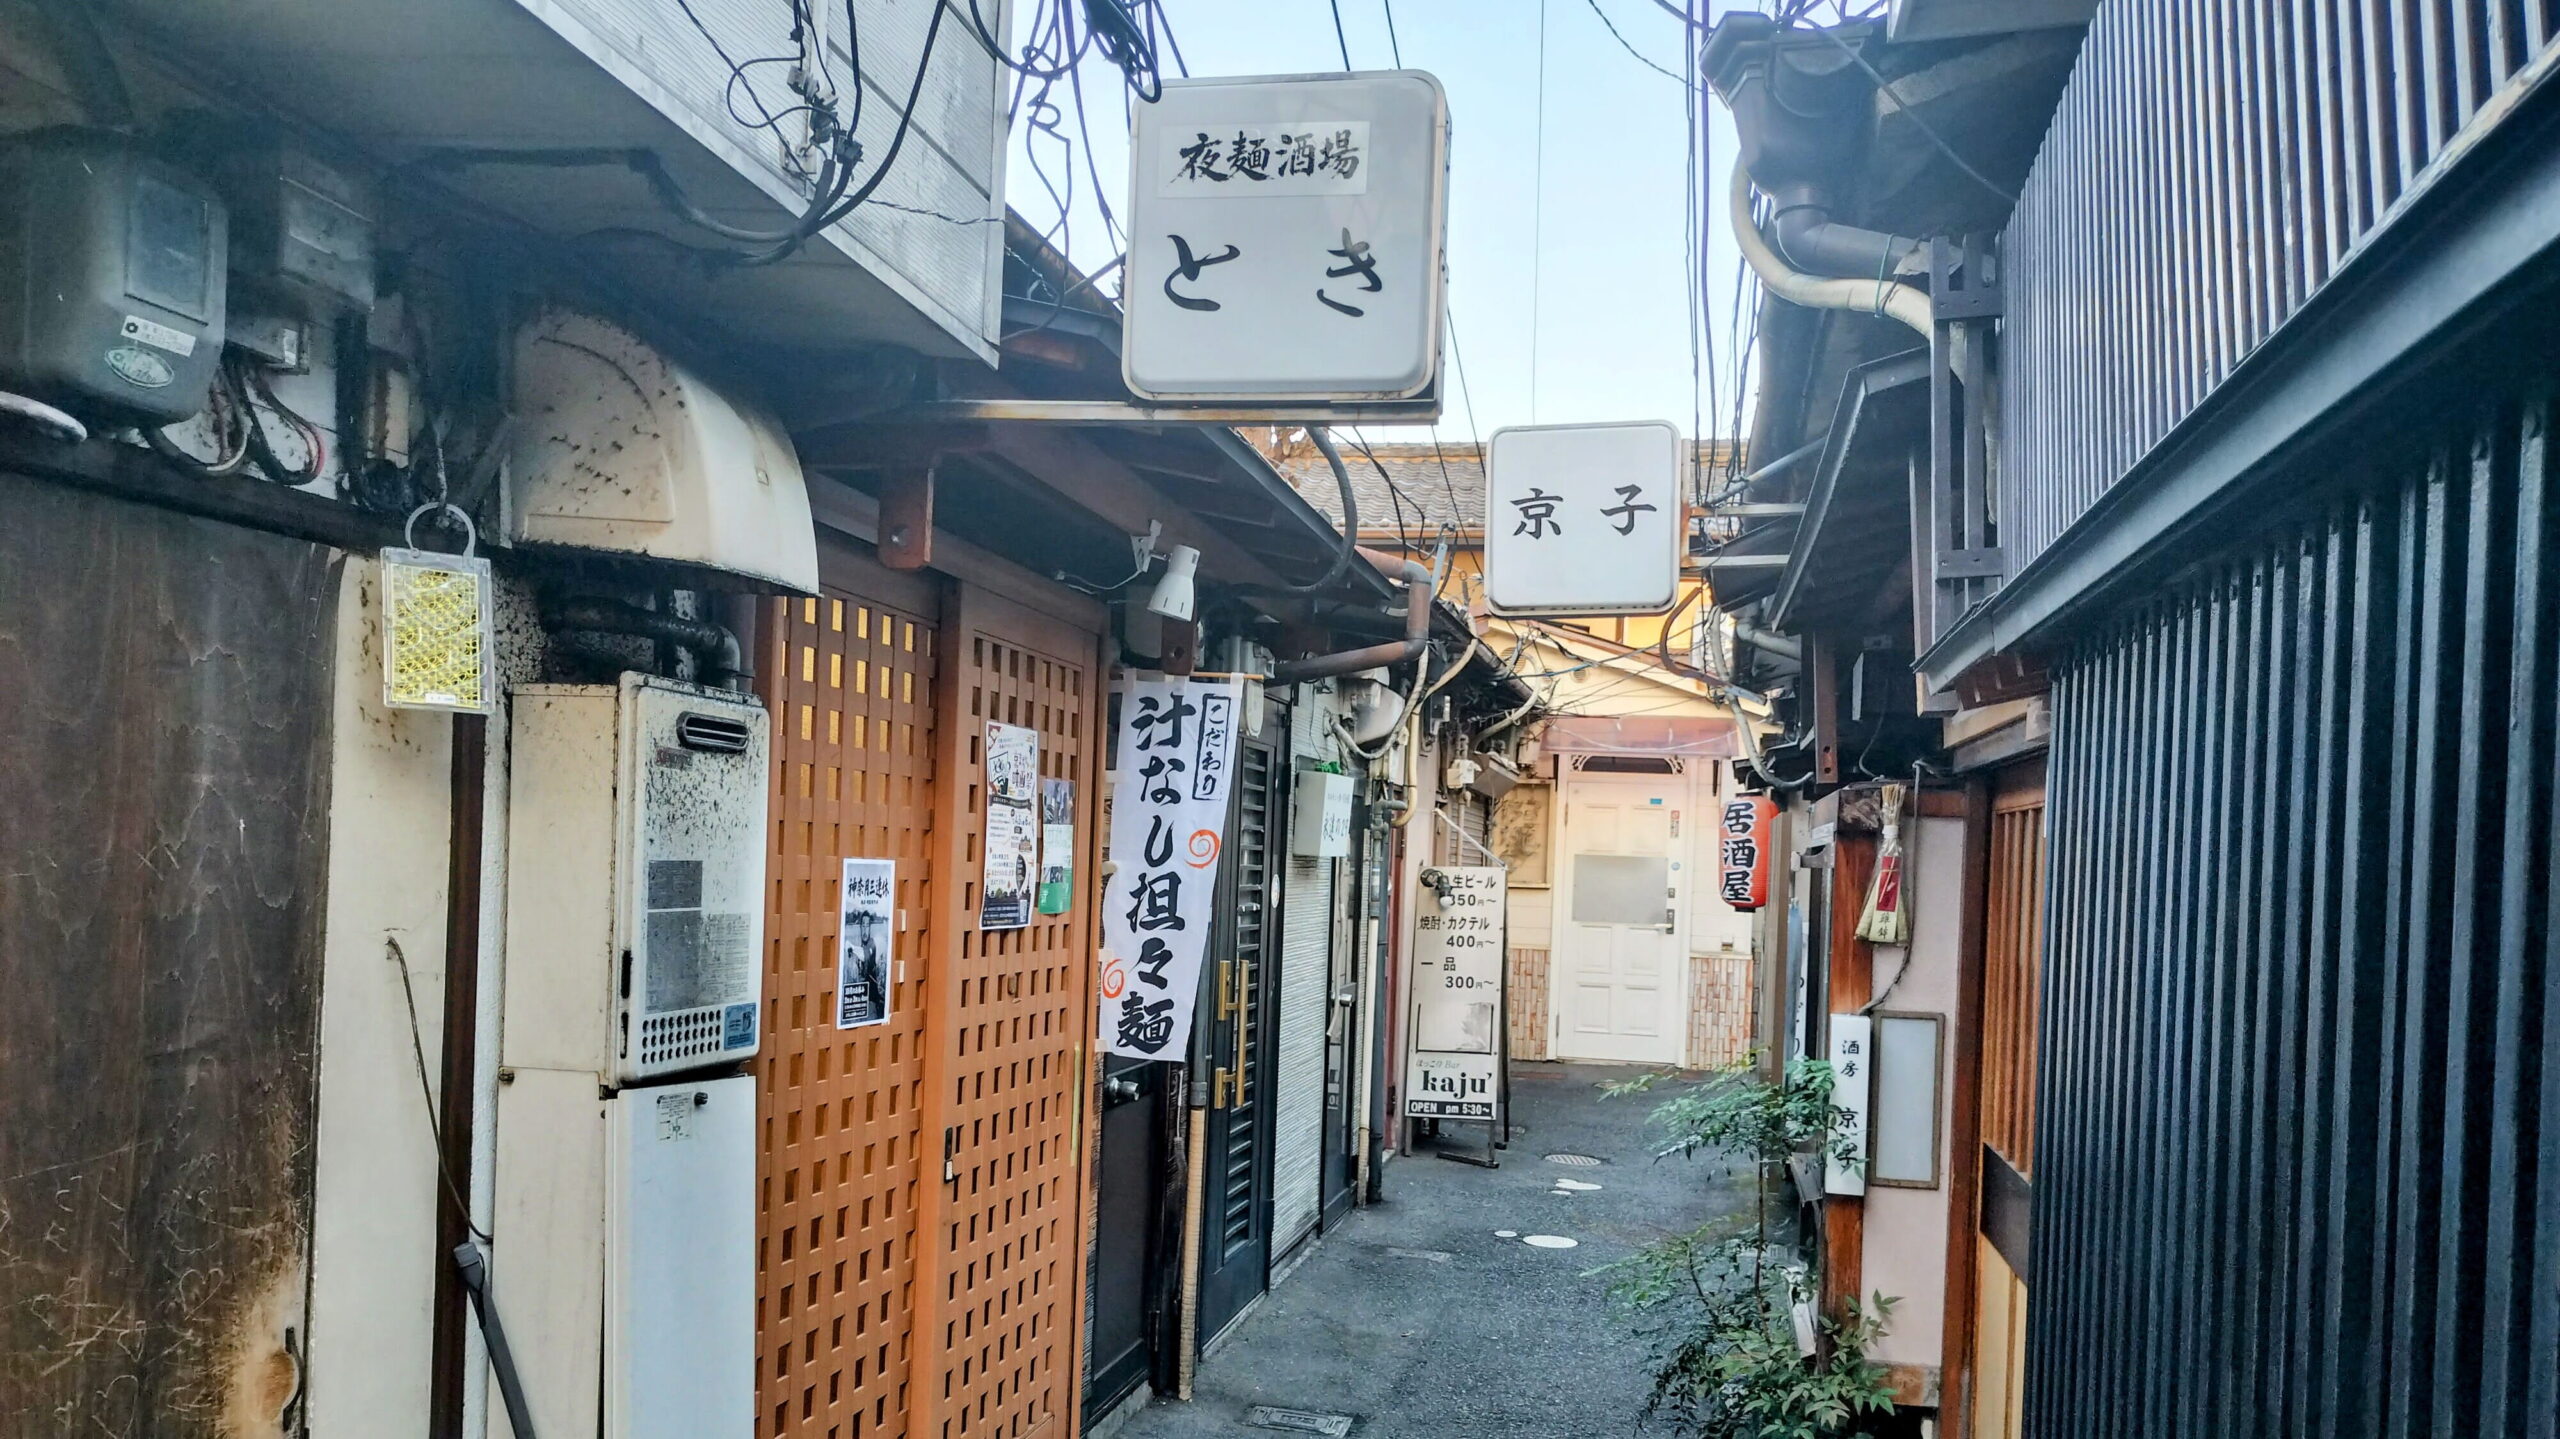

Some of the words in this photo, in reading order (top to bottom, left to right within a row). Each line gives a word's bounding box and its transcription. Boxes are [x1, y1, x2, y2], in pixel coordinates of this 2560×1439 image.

[1164, 227, 1382, 318] とき
[1510, 484, 1657, 540] 京子
[1201, 704, 1225, 796] こだわり
[1720, 801, 1756, 903] 居酒屋
[1452, 874, 1496, 889] 生ビール
[1420, 915, 1490, 931] 焼酎・カクテル
[1420, 956, 1456, 971] 一品
[1841, 1040, 1860, 1078] 酒房
[1411, 1102, 1437, 1113] OPEN
[1446, 1104, 1459, 1114] pm
